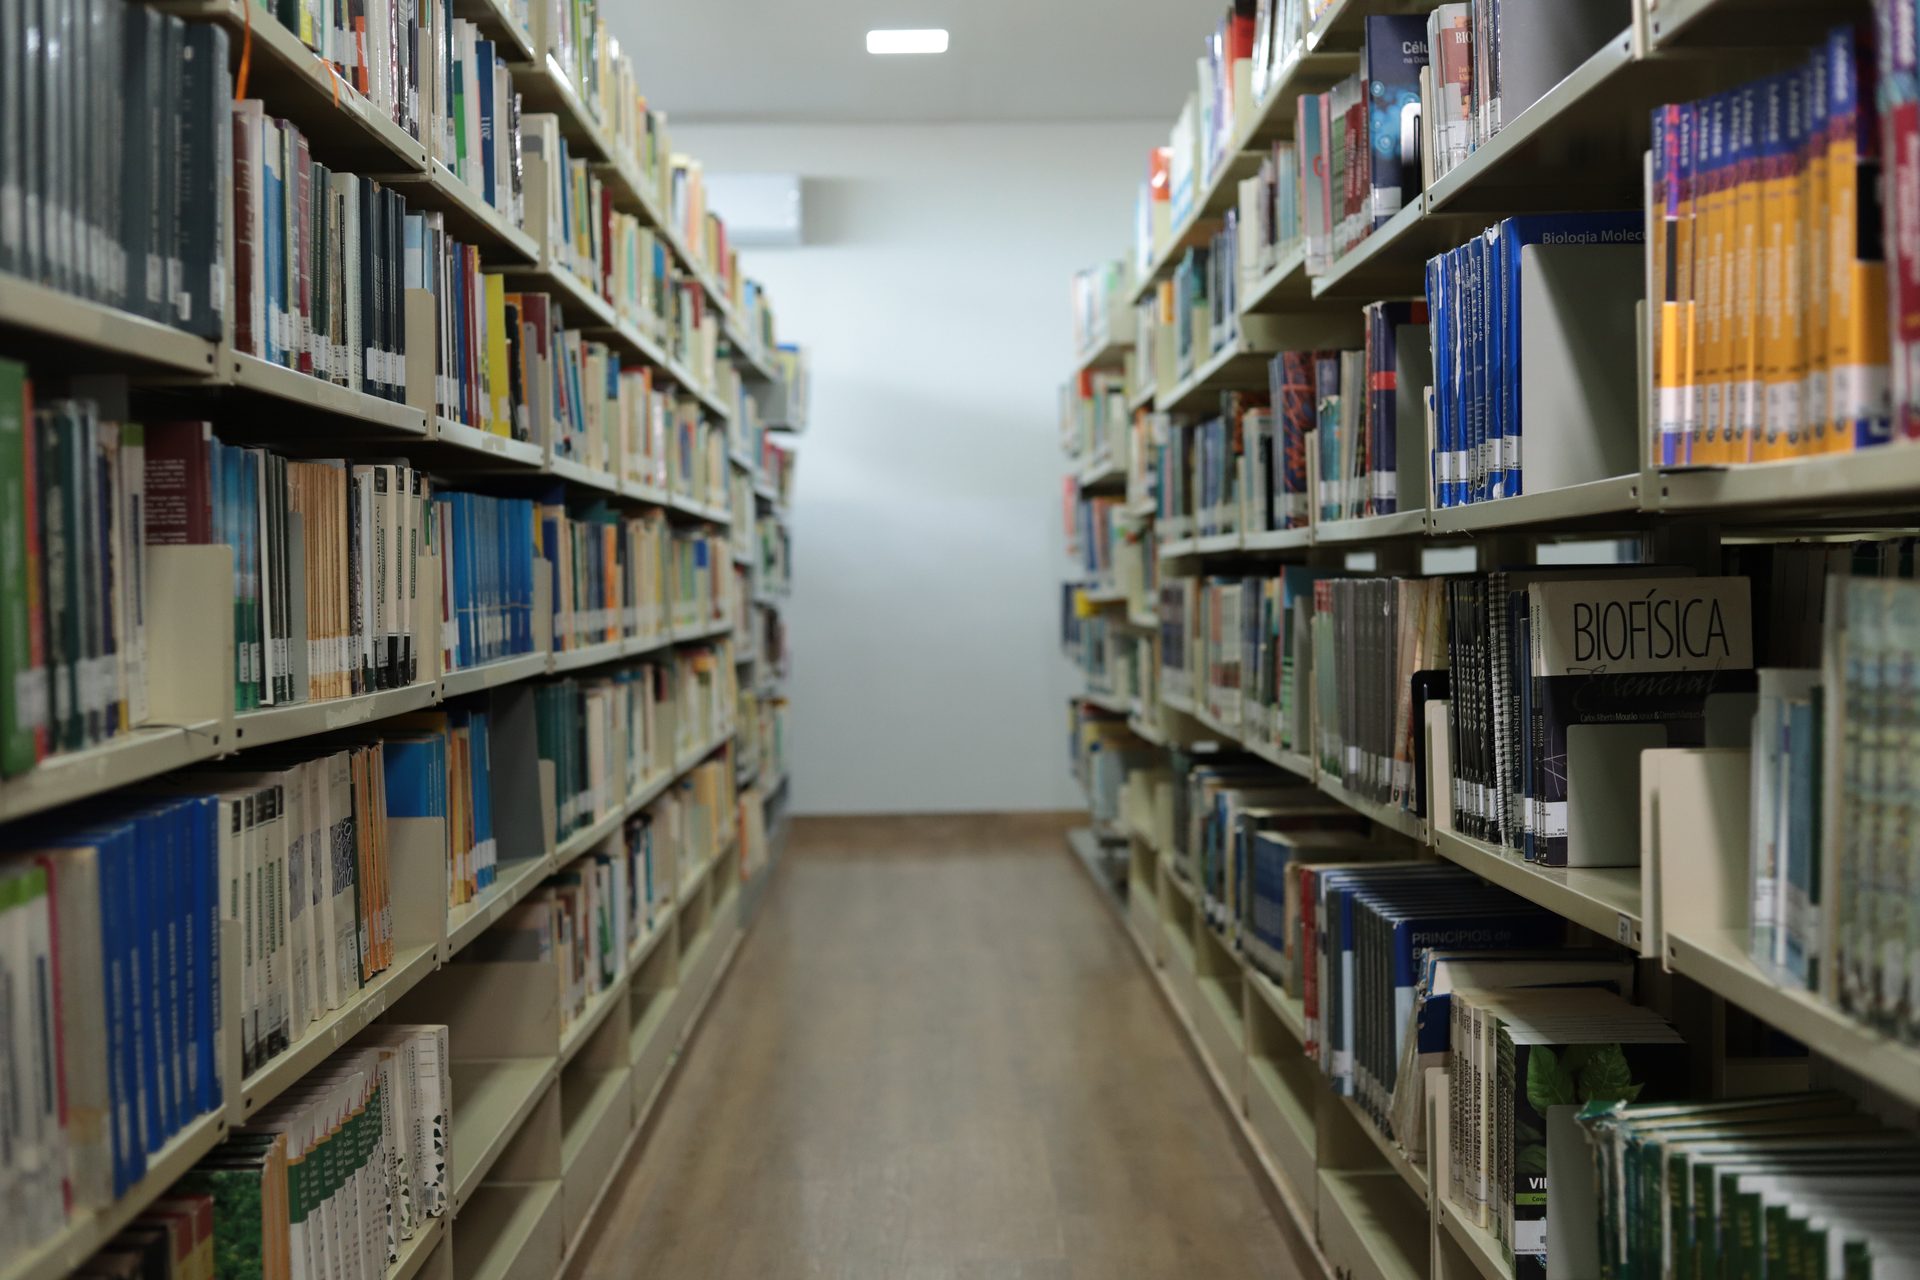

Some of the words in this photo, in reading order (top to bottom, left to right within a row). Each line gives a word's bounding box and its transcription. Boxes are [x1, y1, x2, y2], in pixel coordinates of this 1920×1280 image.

[1542, 232, 1598, 246] Biologia
[1573, 588, 1730, 662] BIOFÍSICA
[1412, 929, 1493, 945] PRINCÍPIOS
